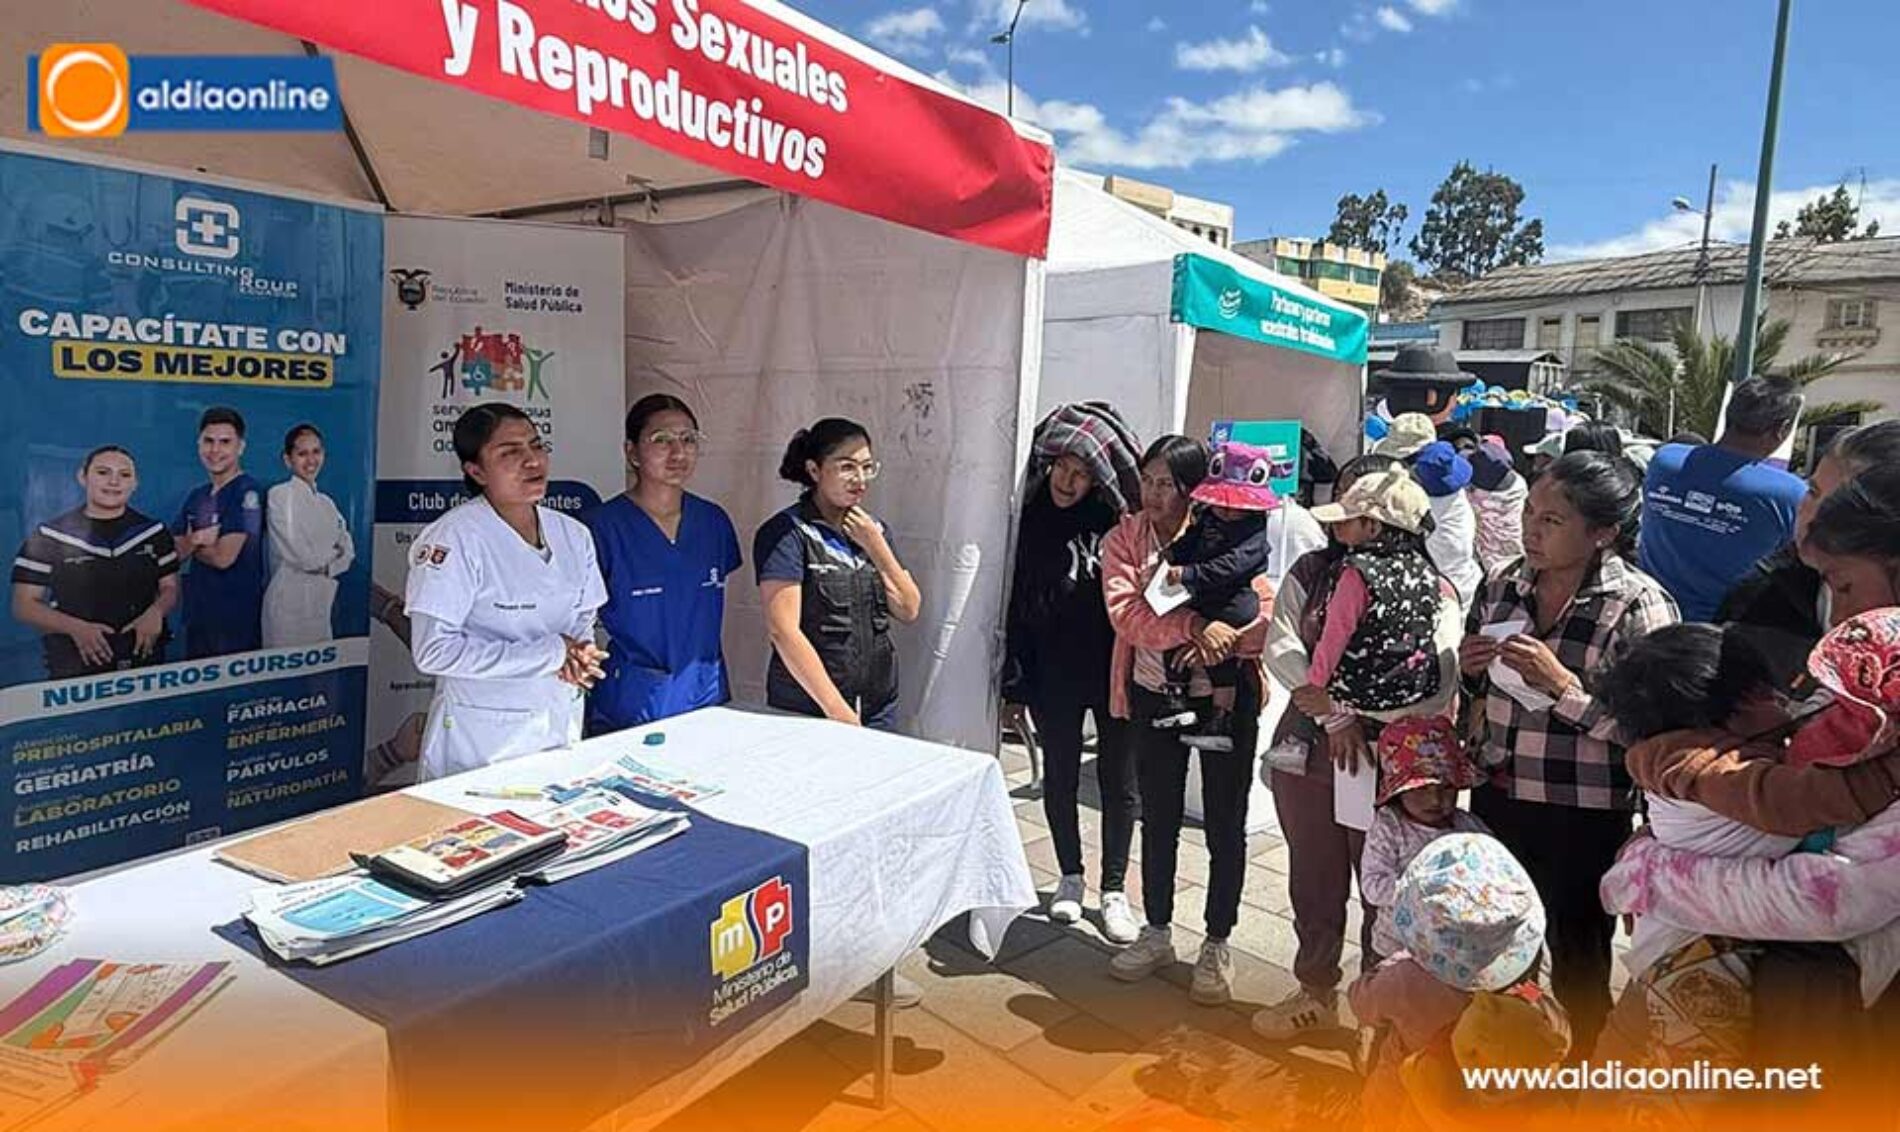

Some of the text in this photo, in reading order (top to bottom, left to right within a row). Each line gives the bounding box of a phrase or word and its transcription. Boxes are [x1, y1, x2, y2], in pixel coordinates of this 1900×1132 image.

[672, 0, 849, 113] Sexuales
[444, 0, 827, 179] y Reproductivos
[107, 252, 254, 279] CONSULTING
[504, 281, 580, 298] Ministerio de
[506, 296, 537, 312] Salud
[19, 308, 347, 355] CAPACÍTATE CON
[61, 346, 328, 382] LOS MEJORES
[408, 492, 446, 510] Club
[42, 646, 338, 708] NUESTROS CURSOS
[227, 694, 327, 724] FARMACIA
[13, 717, 204, 765] PREHOSPITALARIA
[226, 714, 346, 749] ENFERMERÍA
[14, 752, 156, 796] GERIATRÍA
[227, 768, 348, 809] NATUROPATÍA
[14, 778, 182, 828] LABORATORIO
[16, 800, 192, 854] REHABILITACIÓN
[714, 960, 774, 1006] Ministerio
[709, 989, 749, 1028] Salud
